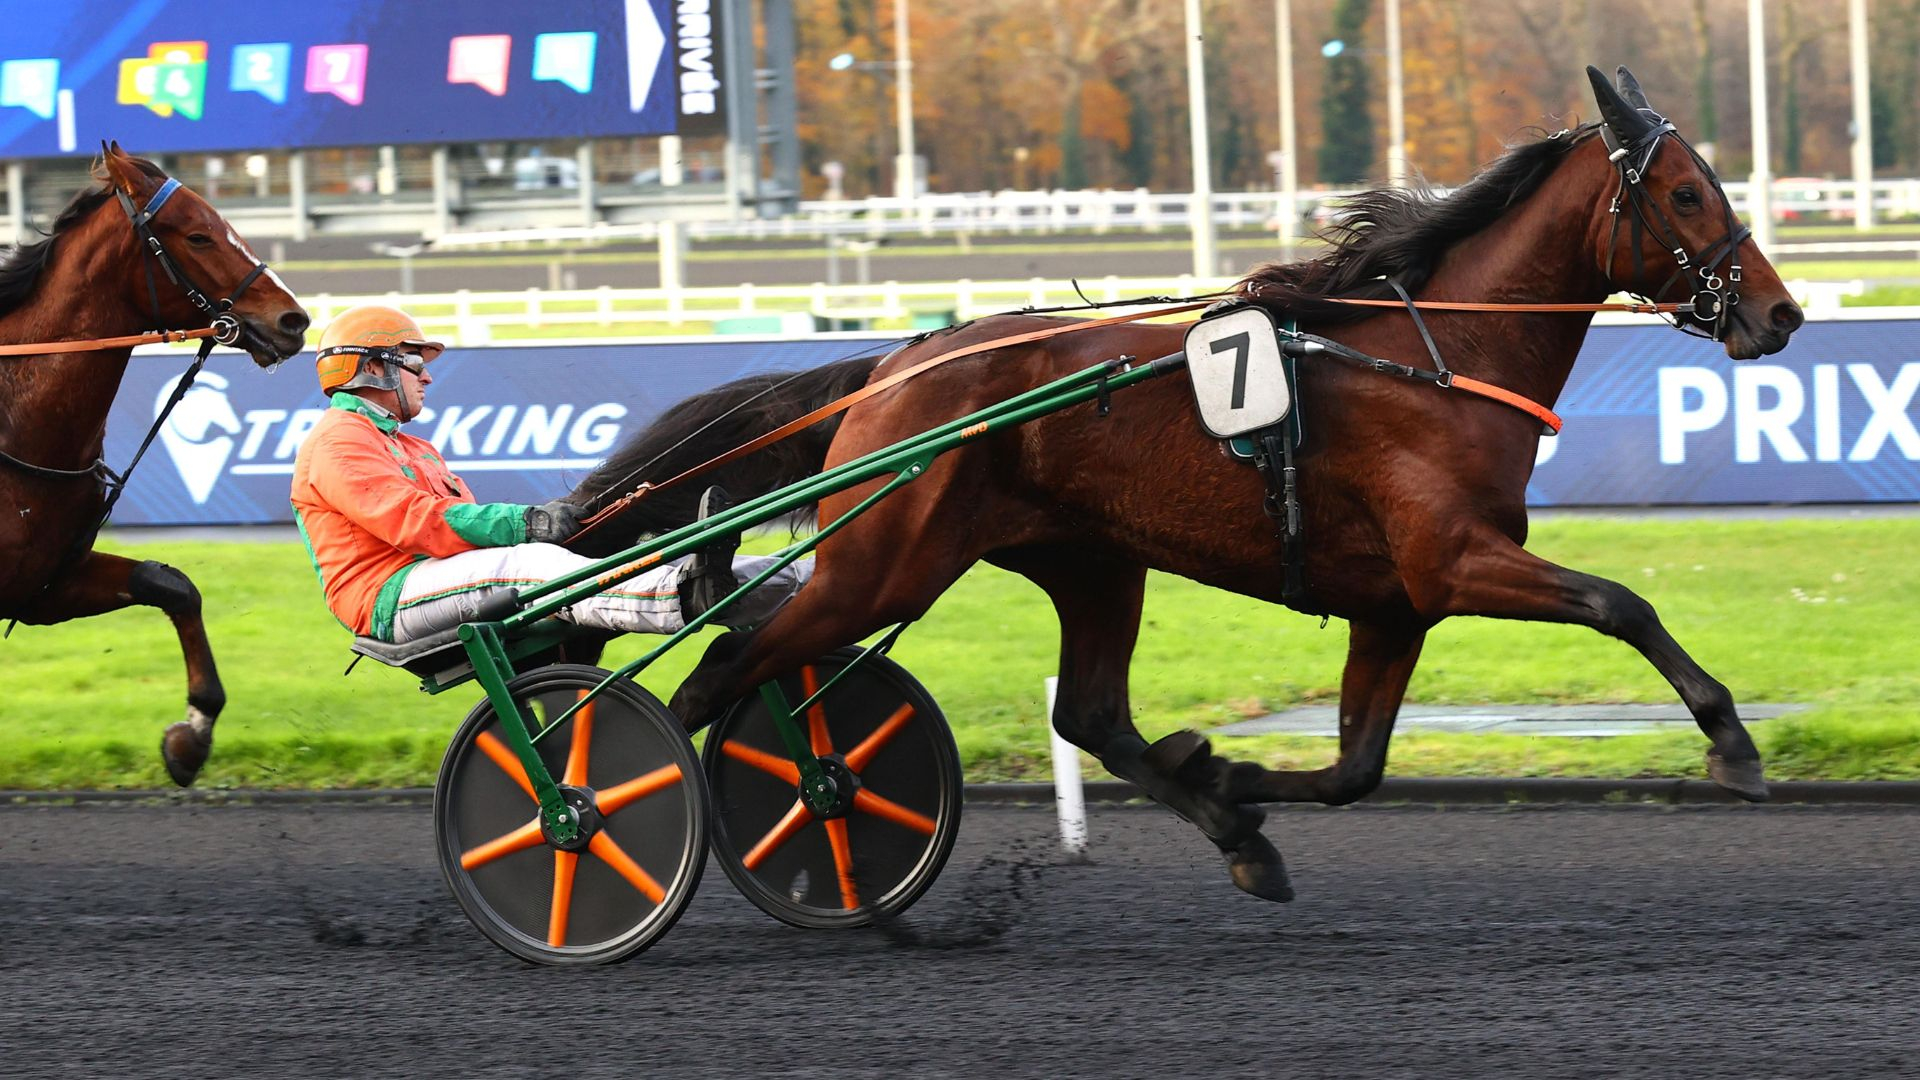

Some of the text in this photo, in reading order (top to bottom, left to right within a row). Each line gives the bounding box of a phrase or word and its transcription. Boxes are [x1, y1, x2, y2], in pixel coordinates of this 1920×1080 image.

[246, 51, 272, 82] 2
[1209, 331, 1250, 410] 7
[238, 403, 628, 460] TRKING
[1657, 361, 1920, 465] PRIX
